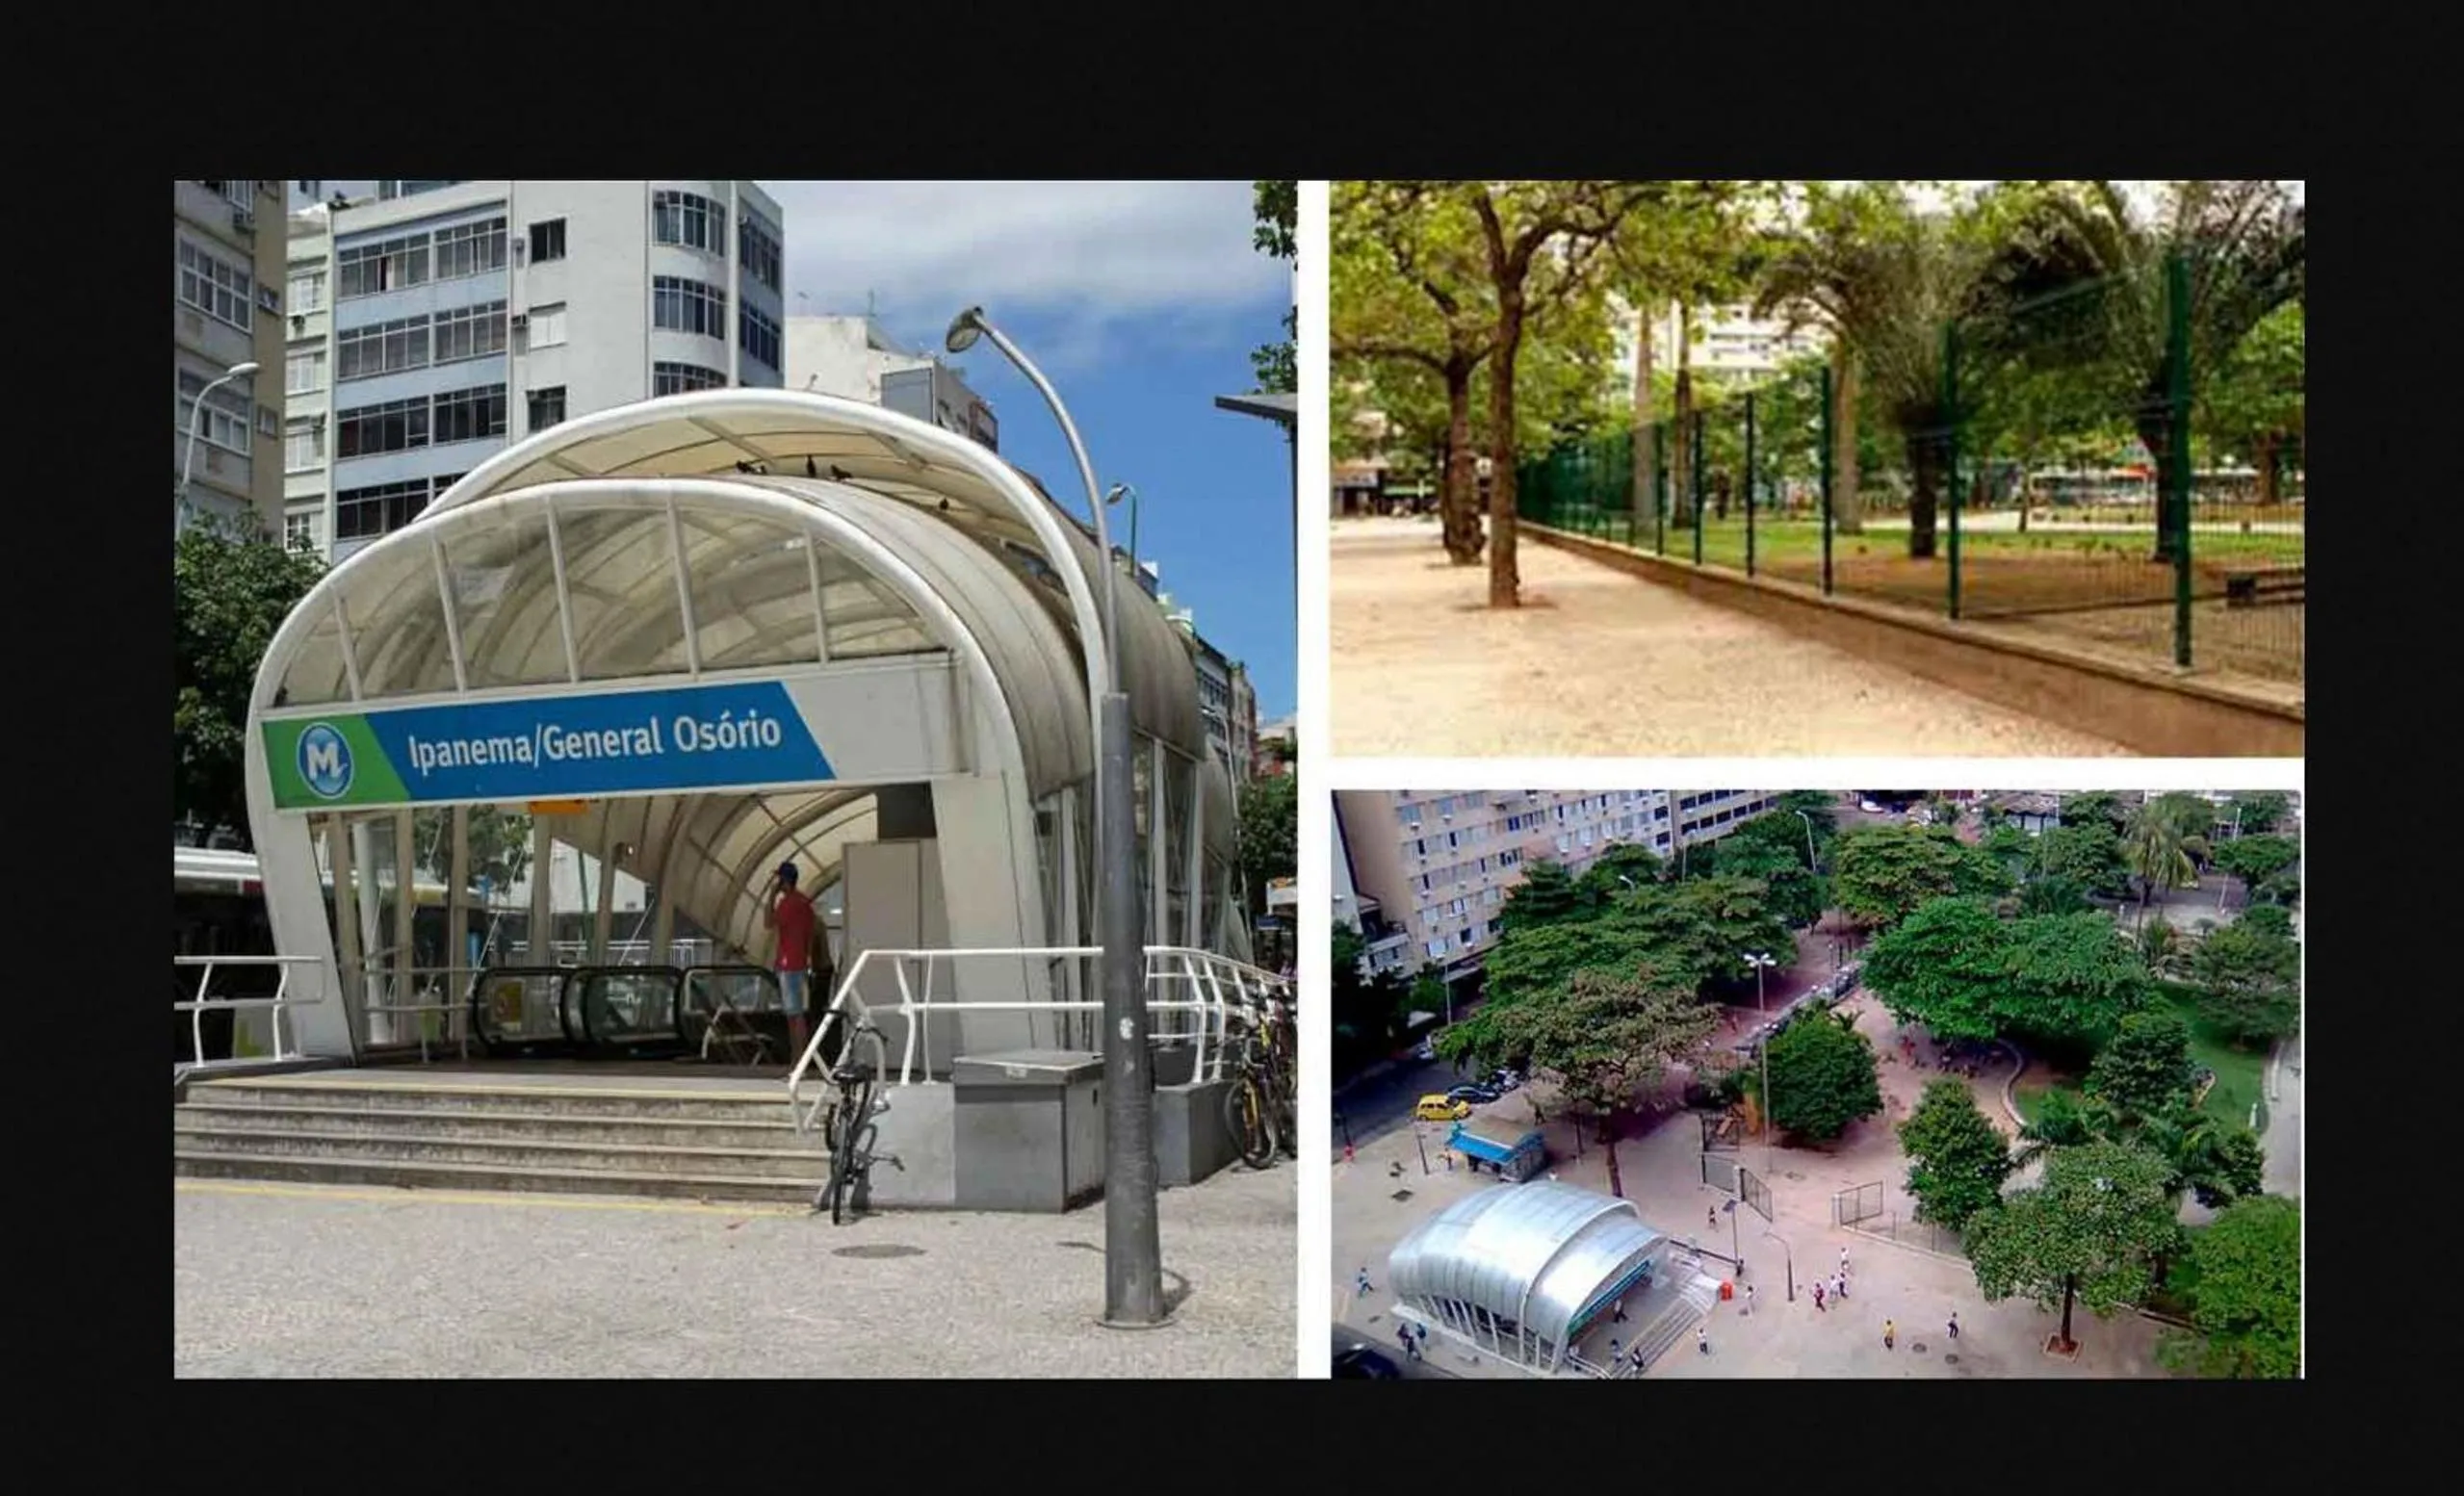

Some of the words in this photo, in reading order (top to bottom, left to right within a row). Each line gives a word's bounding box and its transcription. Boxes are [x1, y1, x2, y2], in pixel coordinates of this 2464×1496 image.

[305, 739, 348, 781] M
[407, 715, 665, 777] Ipanema/General
[674, 708, 782, 753] Osório
